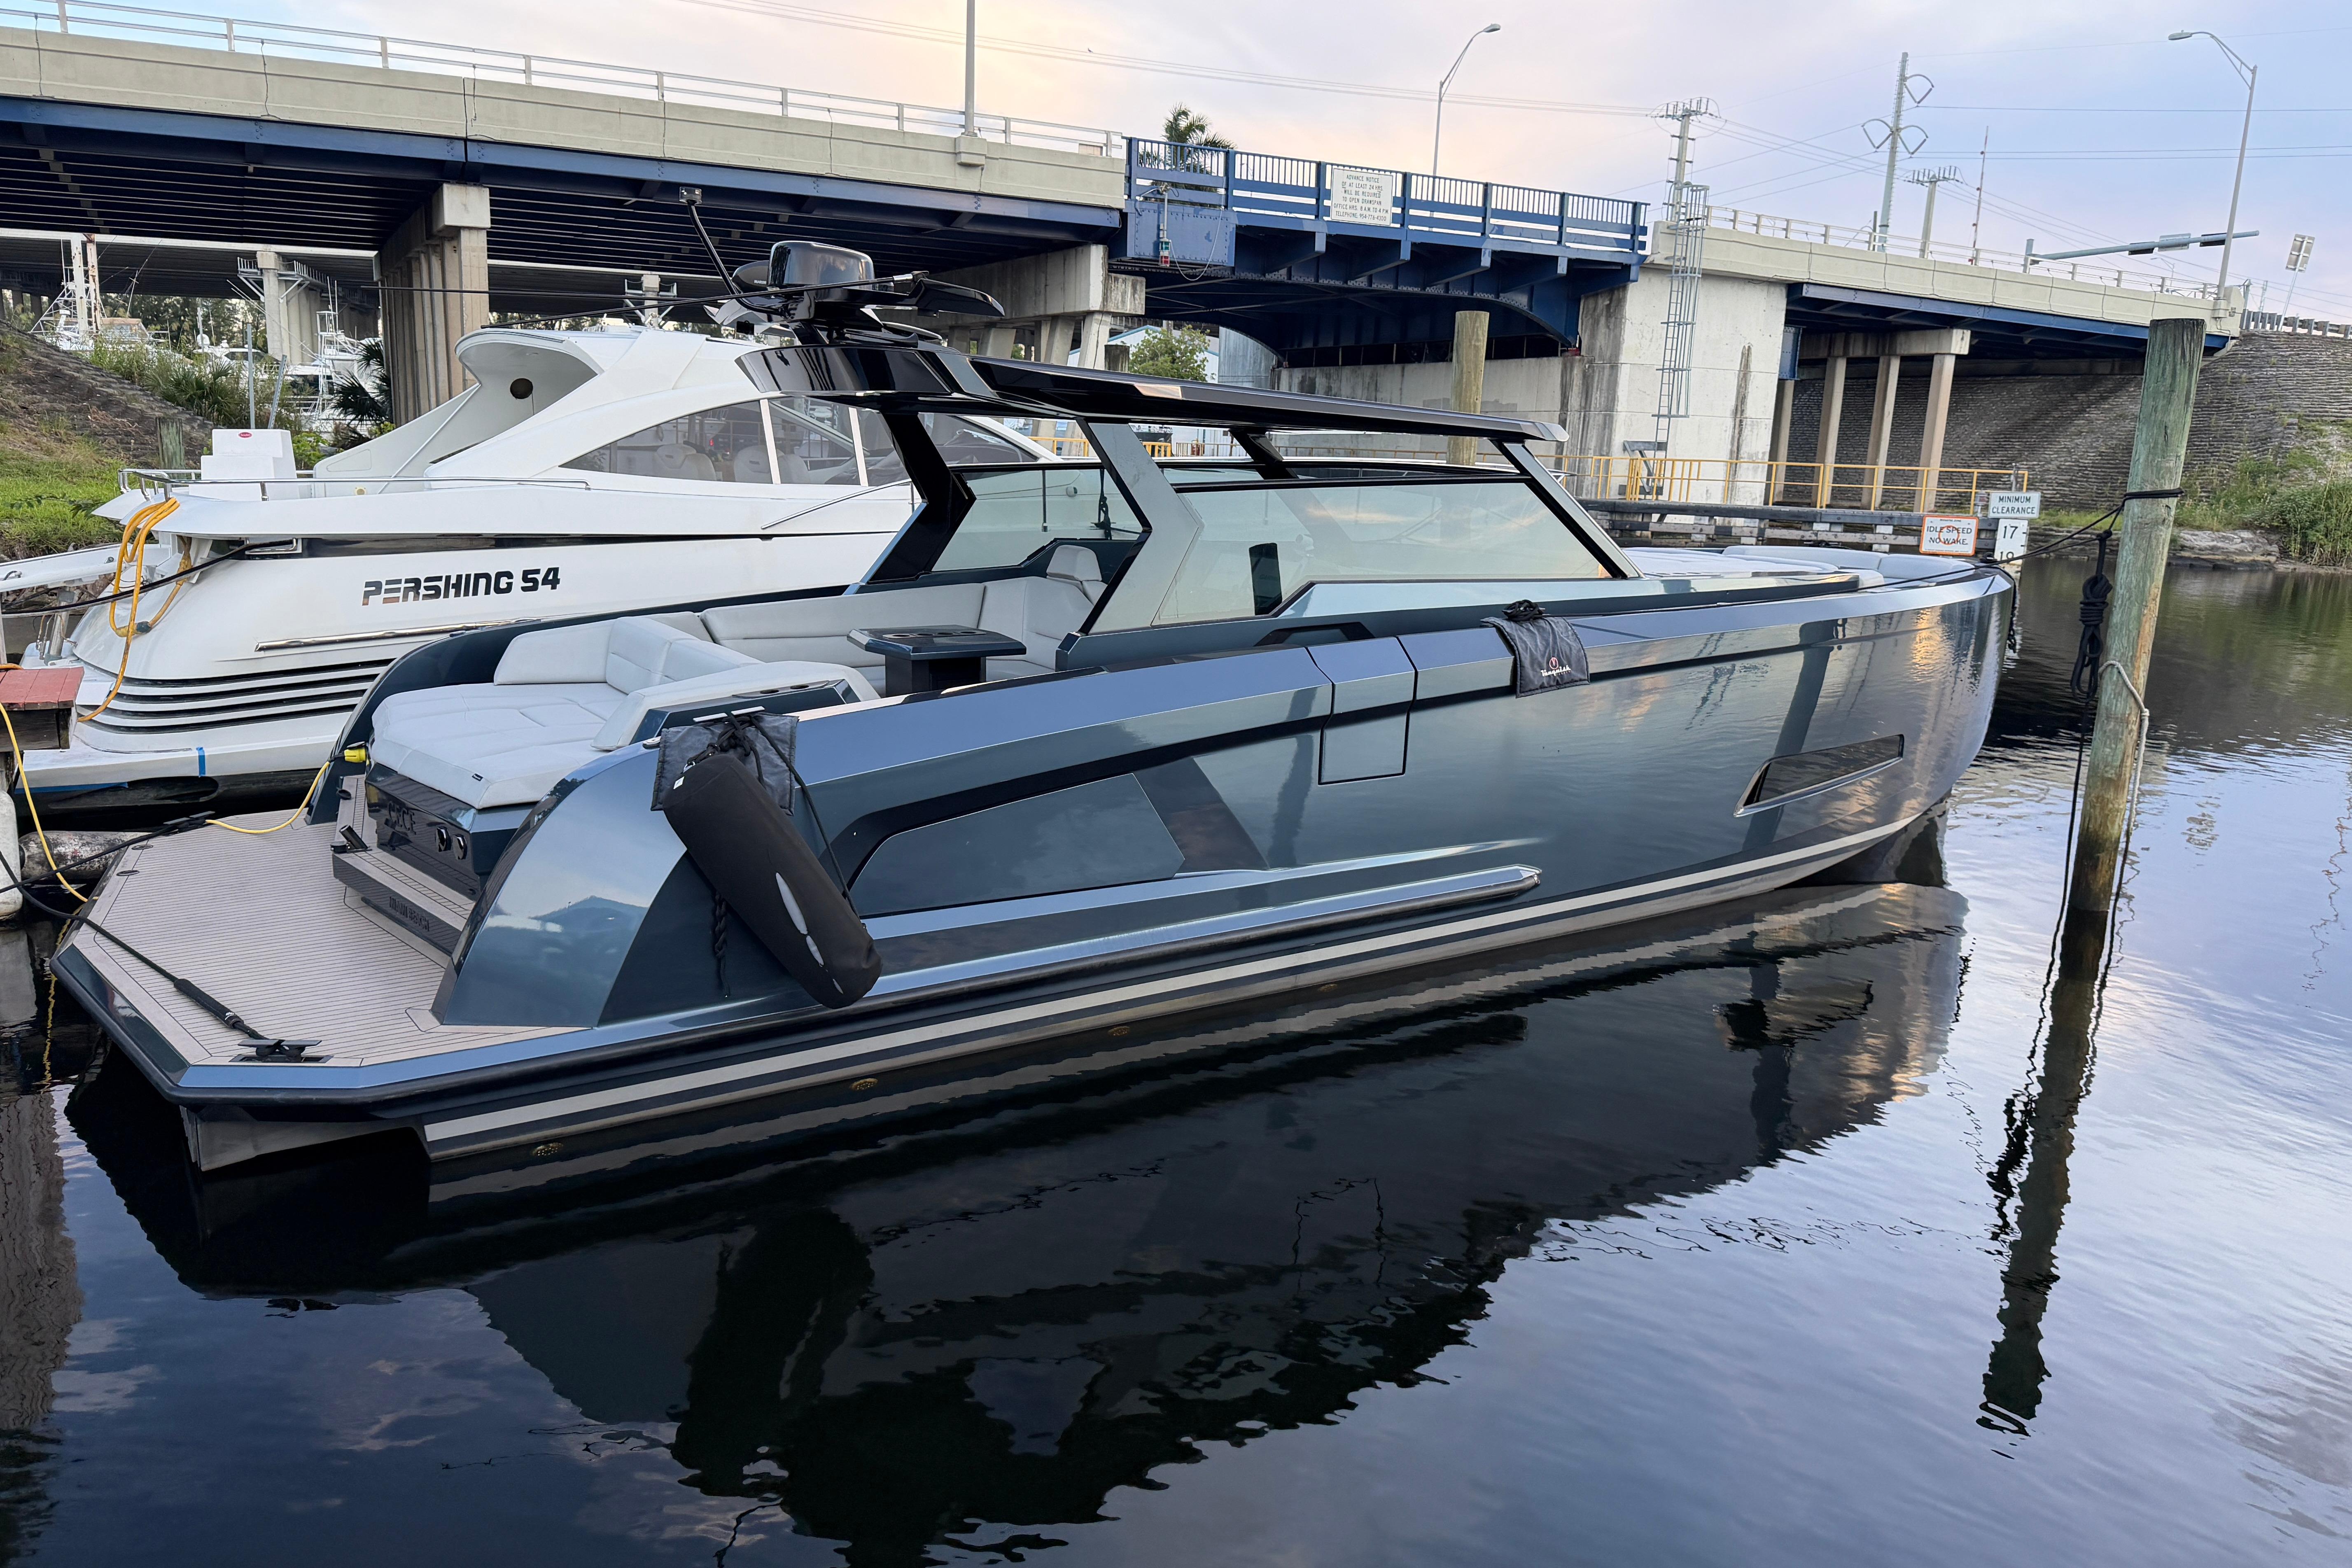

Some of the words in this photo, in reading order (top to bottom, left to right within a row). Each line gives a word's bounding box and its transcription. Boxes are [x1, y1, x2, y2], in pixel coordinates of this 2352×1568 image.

[1360, 213, 1386, 222] 954-776-4300
[2003, 525, 2018, 539] 17
[362, 570, 514, 606] PERSHING
[520, 567, 560, 593] 54
[1540, 665, 1571, 677] Vanquish
